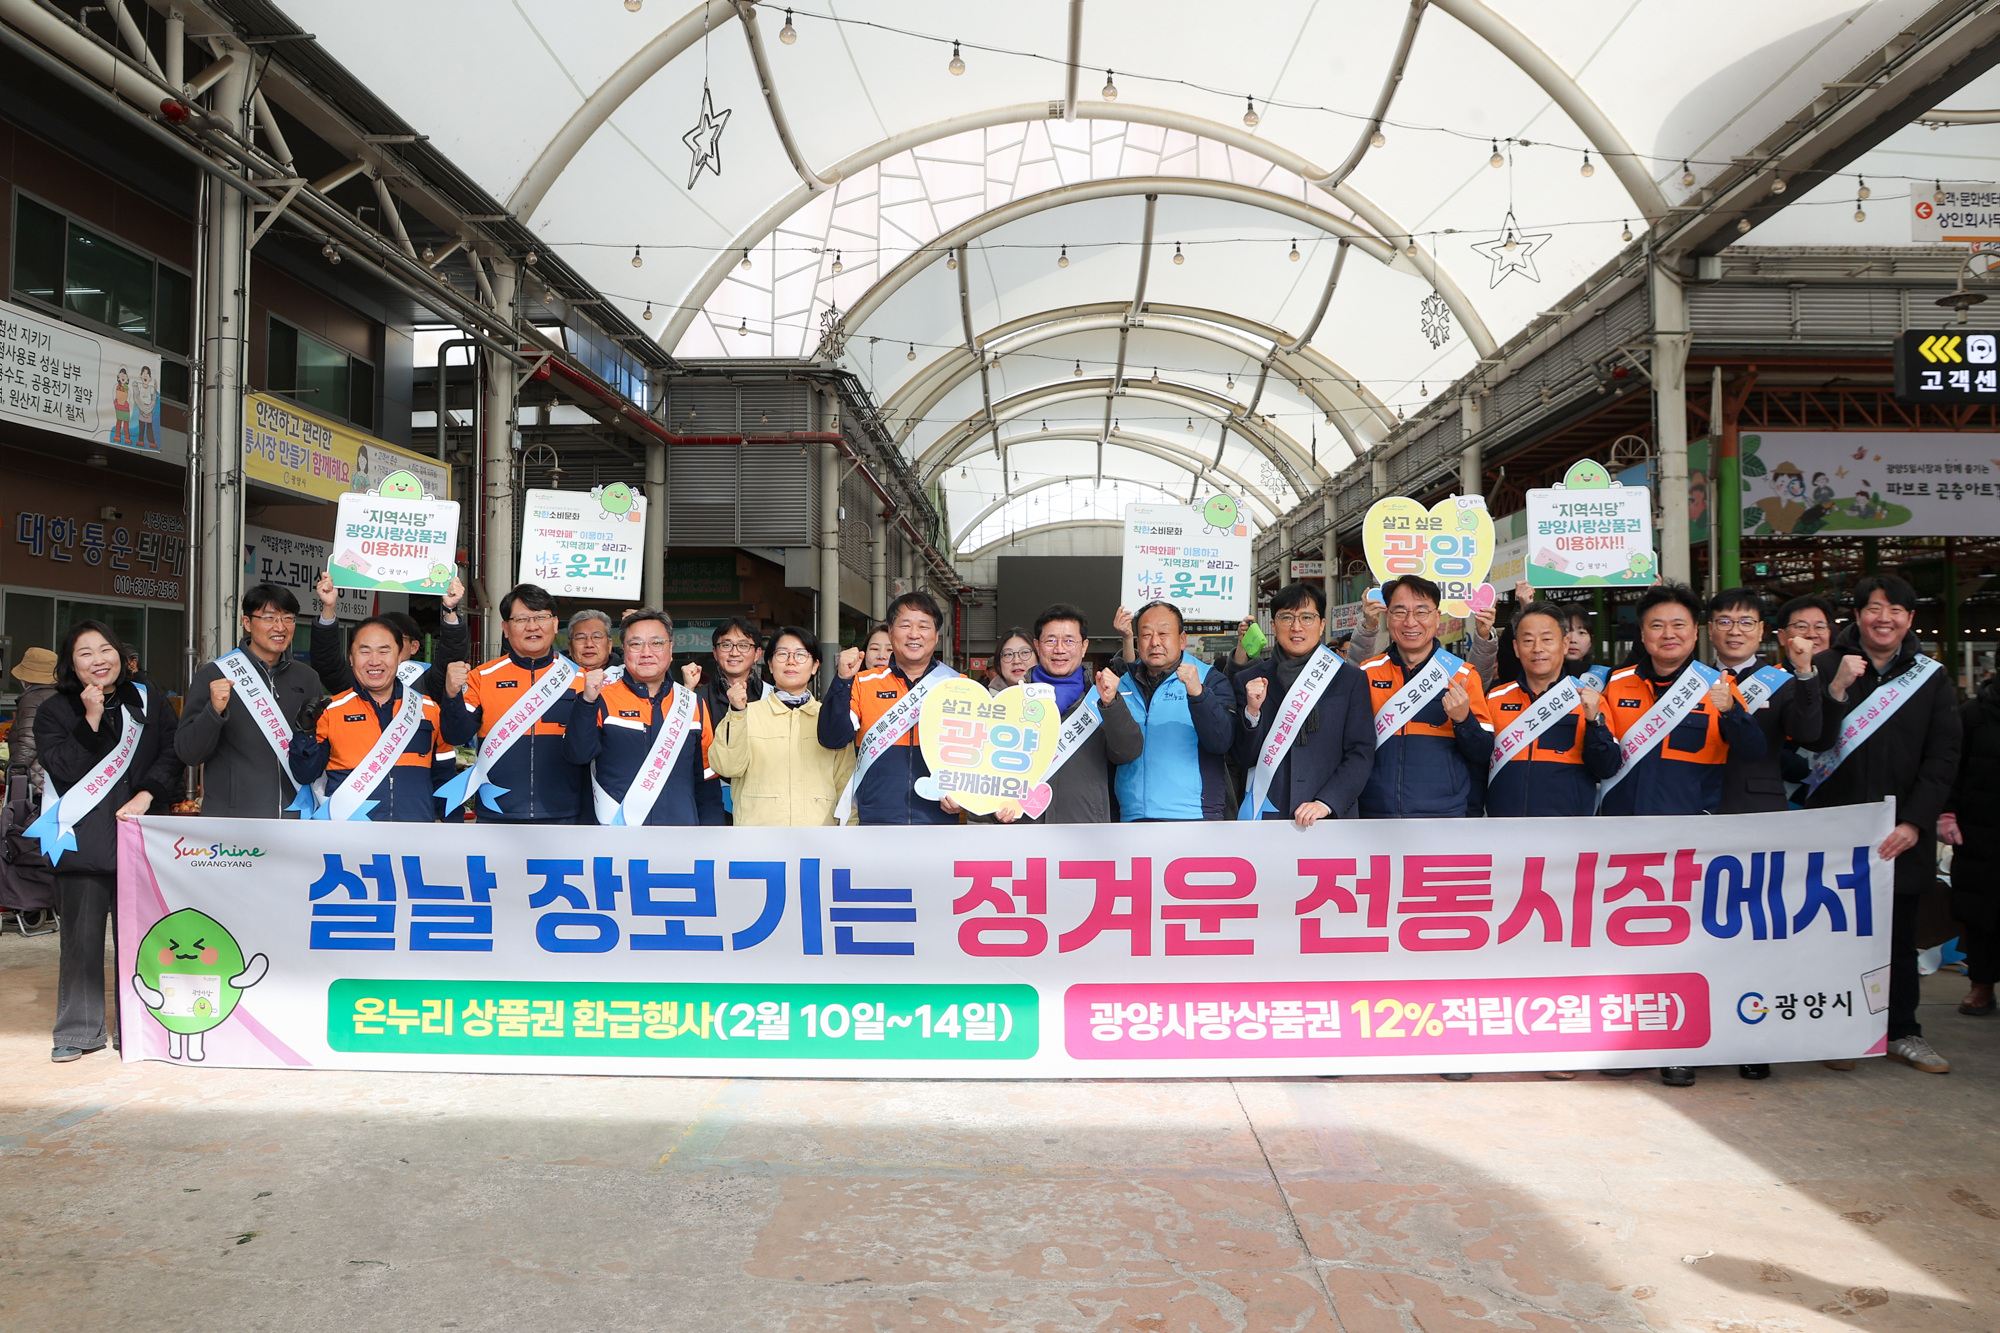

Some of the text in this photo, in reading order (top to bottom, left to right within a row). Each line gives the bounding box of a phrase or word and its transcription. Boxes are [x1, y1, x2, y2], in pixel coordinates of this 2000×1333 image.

[1936, 192, 2000, 207] 객·문화센터
[20, 328, 51, 352] 지키기
[40, 355, 60, 376] 성실
[62, 362, 81, 382] 납부
[1920, 369, 1998, 394] 고객센
[32, 374, 70, 399] 공용전기
[74, 386, 92, 406] 절약
[9, 390, 40, 412] 원산지
[43, 399, 62, 418] 표시
[66, 405, 86, 423] 철저
[256, 400, 332, 451] 안전하고 편리한
[280, 439, 310, 473] 만들기
[312, 451, 350, 484] 함께해요
[1886, 482, 1931, 496] 파브르
[534, 510, 580, 520] 착한소비문화
[1382, 516, 1442, 530] 살고 싶은
[1538, 518, 1642, 535] 광양사랑상품권
[346, 524, 448, 544] 광양사랑상품권
[580, 530, 614, 541] 이용하고
[1134, 526, 1182, 536] 착한소비문화
[1556, 536, 1624, 551] 이용하자!!
[16, 512, 186, 577] 대한통운 택배
[361, 540, 429, 559] 이용하자!!
[602, 543, 632, 552] 살리고~
[1184, 547, 1219, 558] 이용하고
[1384, 534, 1475, 575] 광양
[536, 551, 562, 565] 나도
[566, 554, 626, 580] 웃고!!
[1206, 560, 1240, 570] 살리고~
[535, 566, 560, 580] 너도
[1138, 570, 1166, 584] 나도
[1170, 572, 1234, 600] 웃고!!
[114, 574, 180, 600] 010-6375-2568
[1138, 585, 1165, 600] 너도
[672, 632, 711, 646] 용가능
[226, 657, 290, 758] 함께하는 지역경제활
[874, 684, 928, 734] 지역경제를
[942, 699, 972, 716] 살고
[976, 702, 1007, 720] 싶은
[1376, 668, 1442, 736] 광양에서 소비
[1525, 687, 1576, 732] 광양에서
[1662, 676, 1701, 719] 함께하는
[483, 693, 546, 760] 지역경제활성화
[1262, 688, 1310, 767] 지역경제활성화
[350, 722, 409, 793] 지역경제활성화
[640, 716, 685, 791] 지역경제활성화
[938, 718, 1038, 772] 광양
[84, 725, 137, 796] 지역경제활성화
[938, 770, 1028, 797] 함께해요!
[190, 860, 252, 868] GWANGYANG
[308, 846, 1873, 958] 설날 장보기는 정겨운 전통시장에서
[1089, 992, 1686, 1042] 광양사랑상품권 12%적립(2월 한달)
[1775, 990, 1852, 1022] 광양시
[352, 997, 1014, 1042] 온누리 상품권 환급행사(2월 10일~14일)
